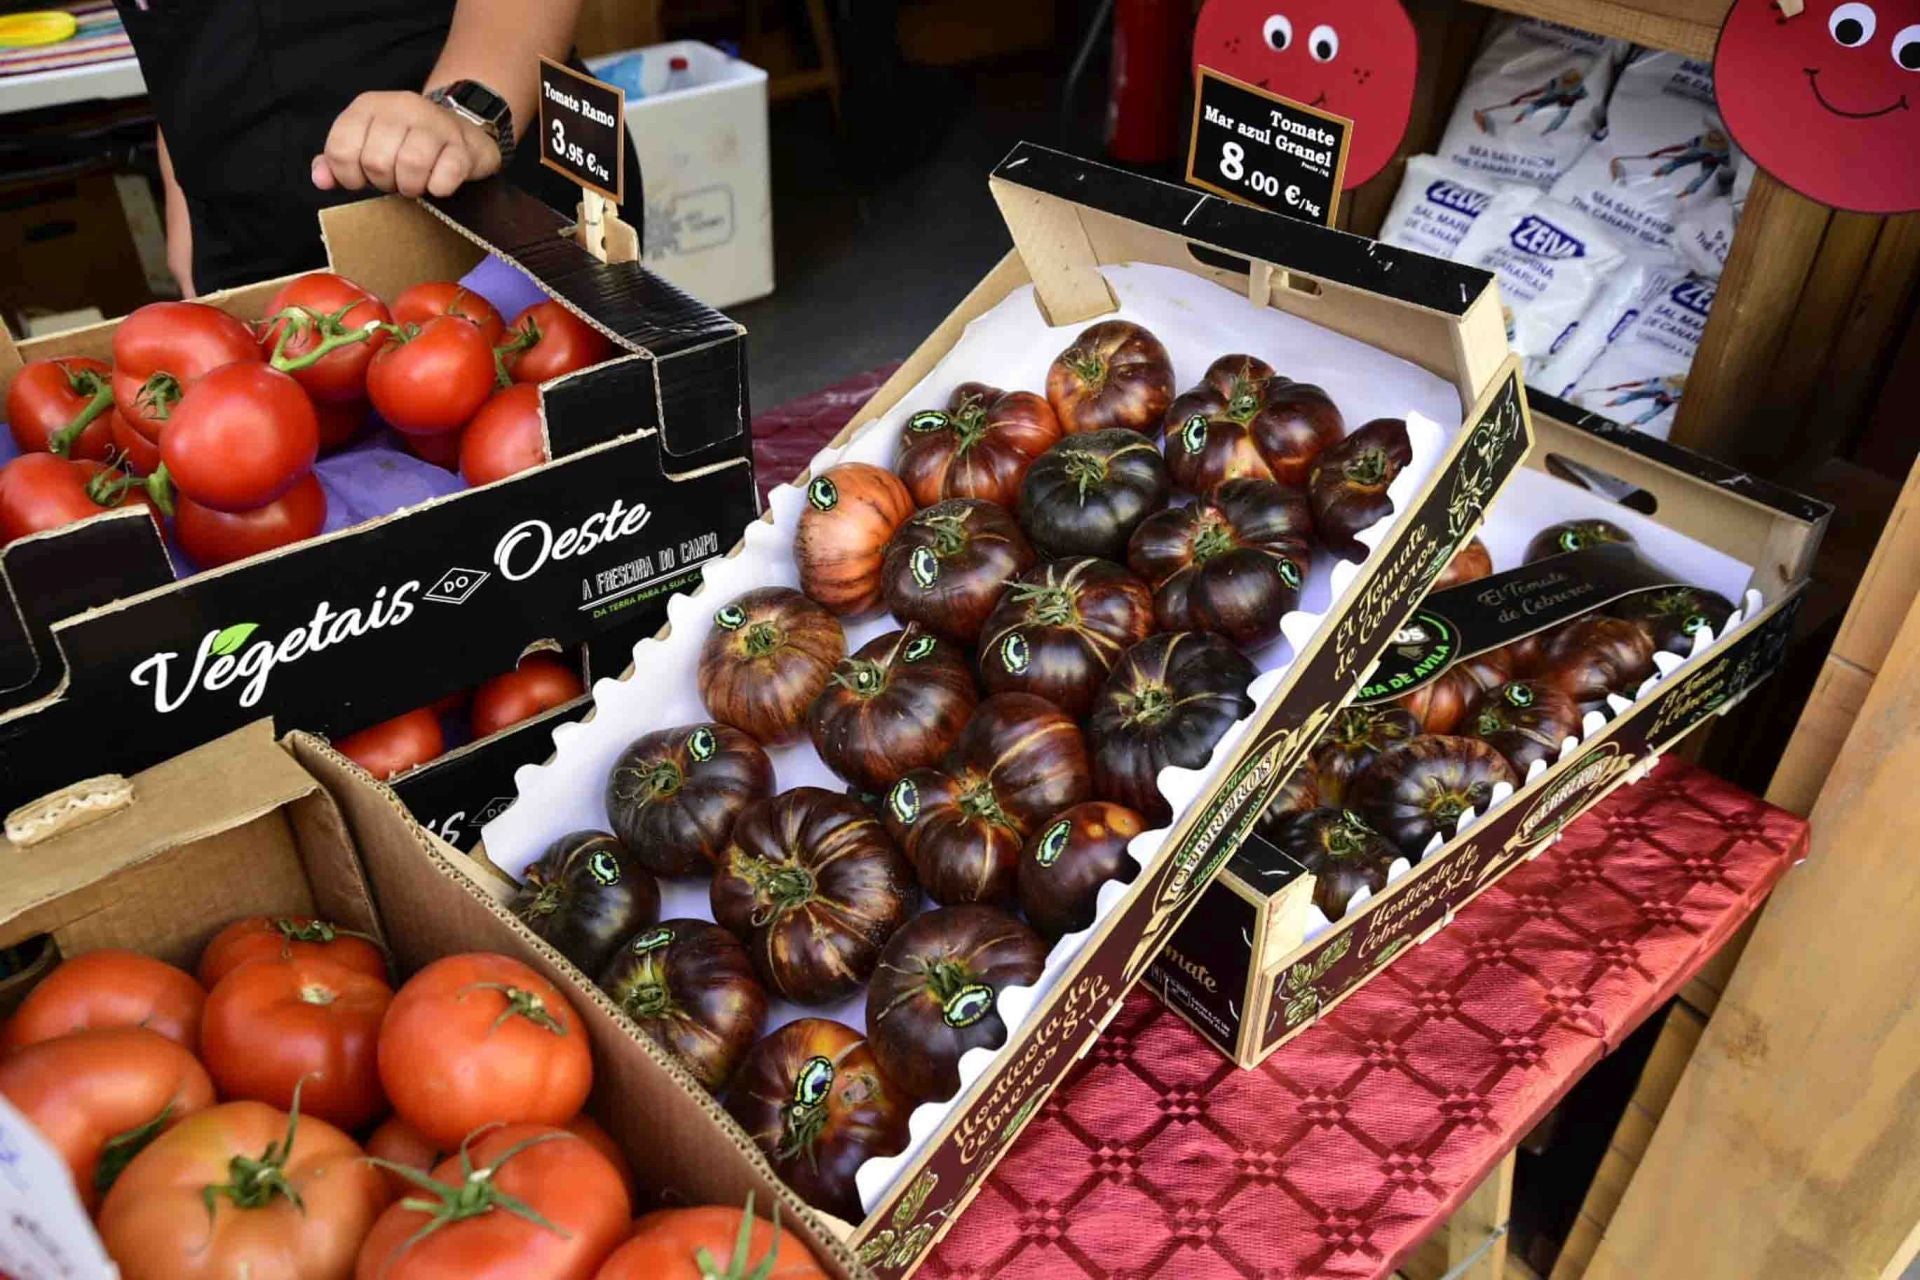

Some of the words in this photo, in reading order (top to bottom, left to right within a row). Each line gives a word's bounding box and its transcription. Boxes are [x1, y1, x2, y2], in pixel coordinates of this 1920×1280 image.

[543, 80, 579, 112] Tomate
[581, 100, 615, 128] Ramo
[1204, 105, 1234, 130] Mar
[1237, 122, 1270, 145] azul
[1275, 134, 1332, 168] Granel
[1270, 110, 1335, 146] Tomate
[551, 118, 584, 166] 3.95
[1219, 141, 1279, 197] 8.00
[1285, 184, 1321, 217] €/kg
[494, 499, 652, 582] Oeste
[582, 578, 593, 601] A
[596, 556, 655, 595] FRESCURA
[658, 547, 676, 572] DO
[680, 531, 718, 564] CAMPO
[1359, 522, 1427, 623] Tomate
[593, 609, 607, 619] DA
[609, 597, 636, 613] TERRA
[638, 588, 661, 601] PARA
[669, 578, 687, 592] SUA
[1334, 648, 1357, 681] de
[1360, 537, 1440, 645] Cebreros
[130, 579, 420, 713] Vegetais
[444, 575, 469, 593] DO
[1170, 751, 1271, 893] CEBREROS
[1456, 844, 1478, 868] de
[1358, 894, 1438, 958] Cebreros
[1064, 975, 1094, 1013] de
[961, 1043, 1060, 1165] Cebreros
